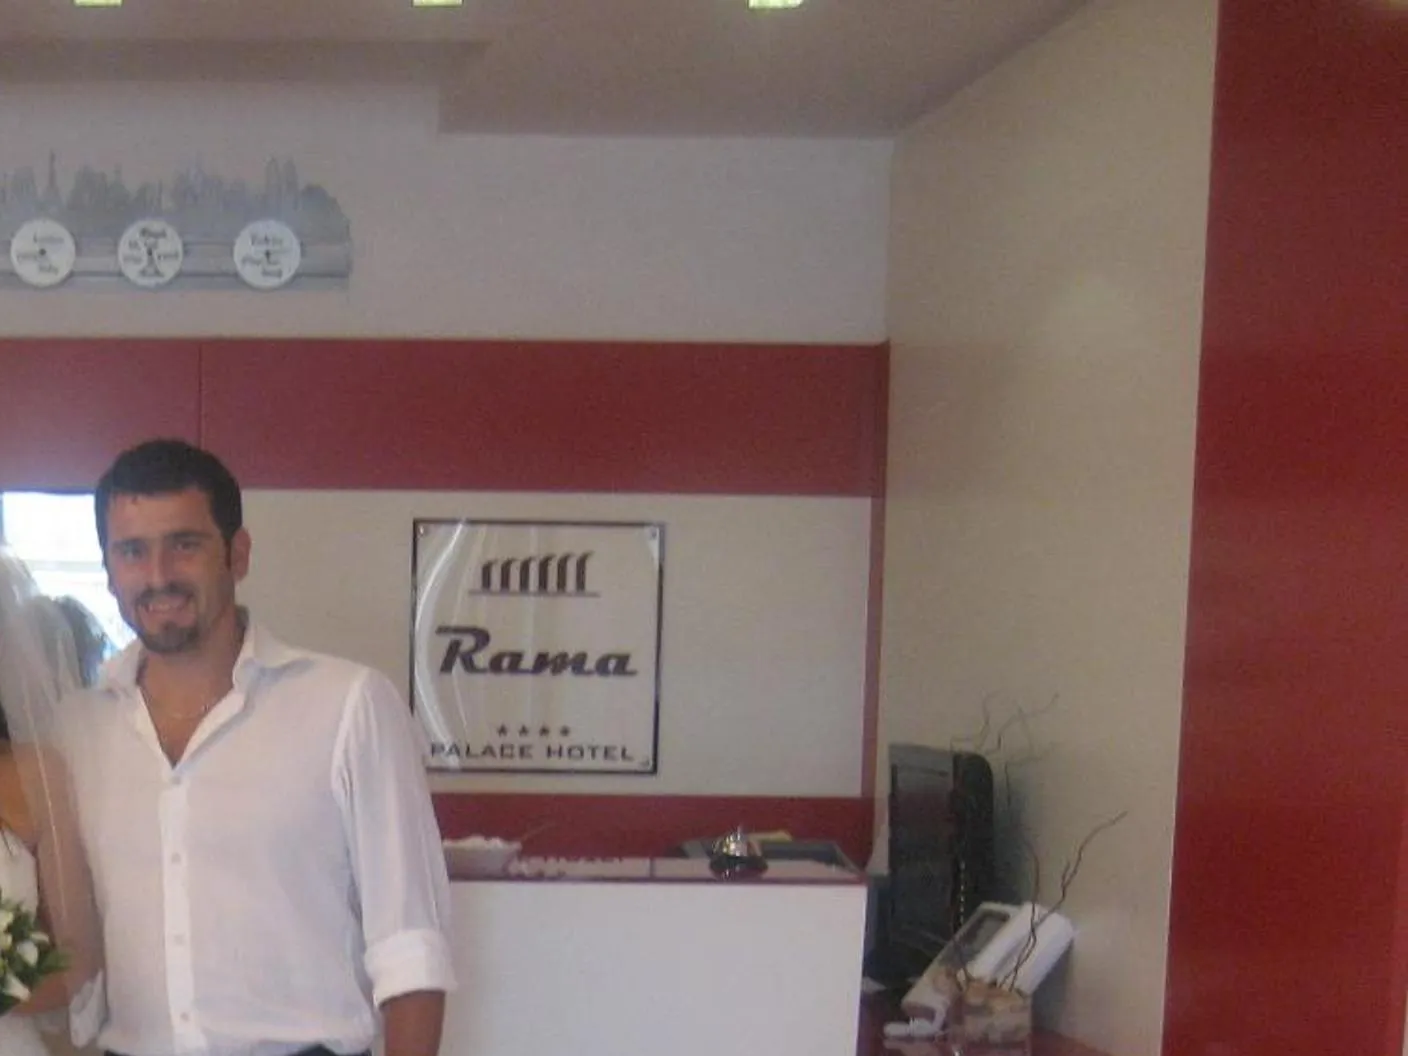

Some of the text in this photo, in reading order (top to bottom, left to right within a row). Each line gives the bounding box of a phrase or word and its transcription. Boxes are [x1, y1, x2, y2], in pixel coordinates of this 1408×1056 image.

[435, 625, 638, 676] Rama
[430, 743, 635, 762] PALACE HOTEL
